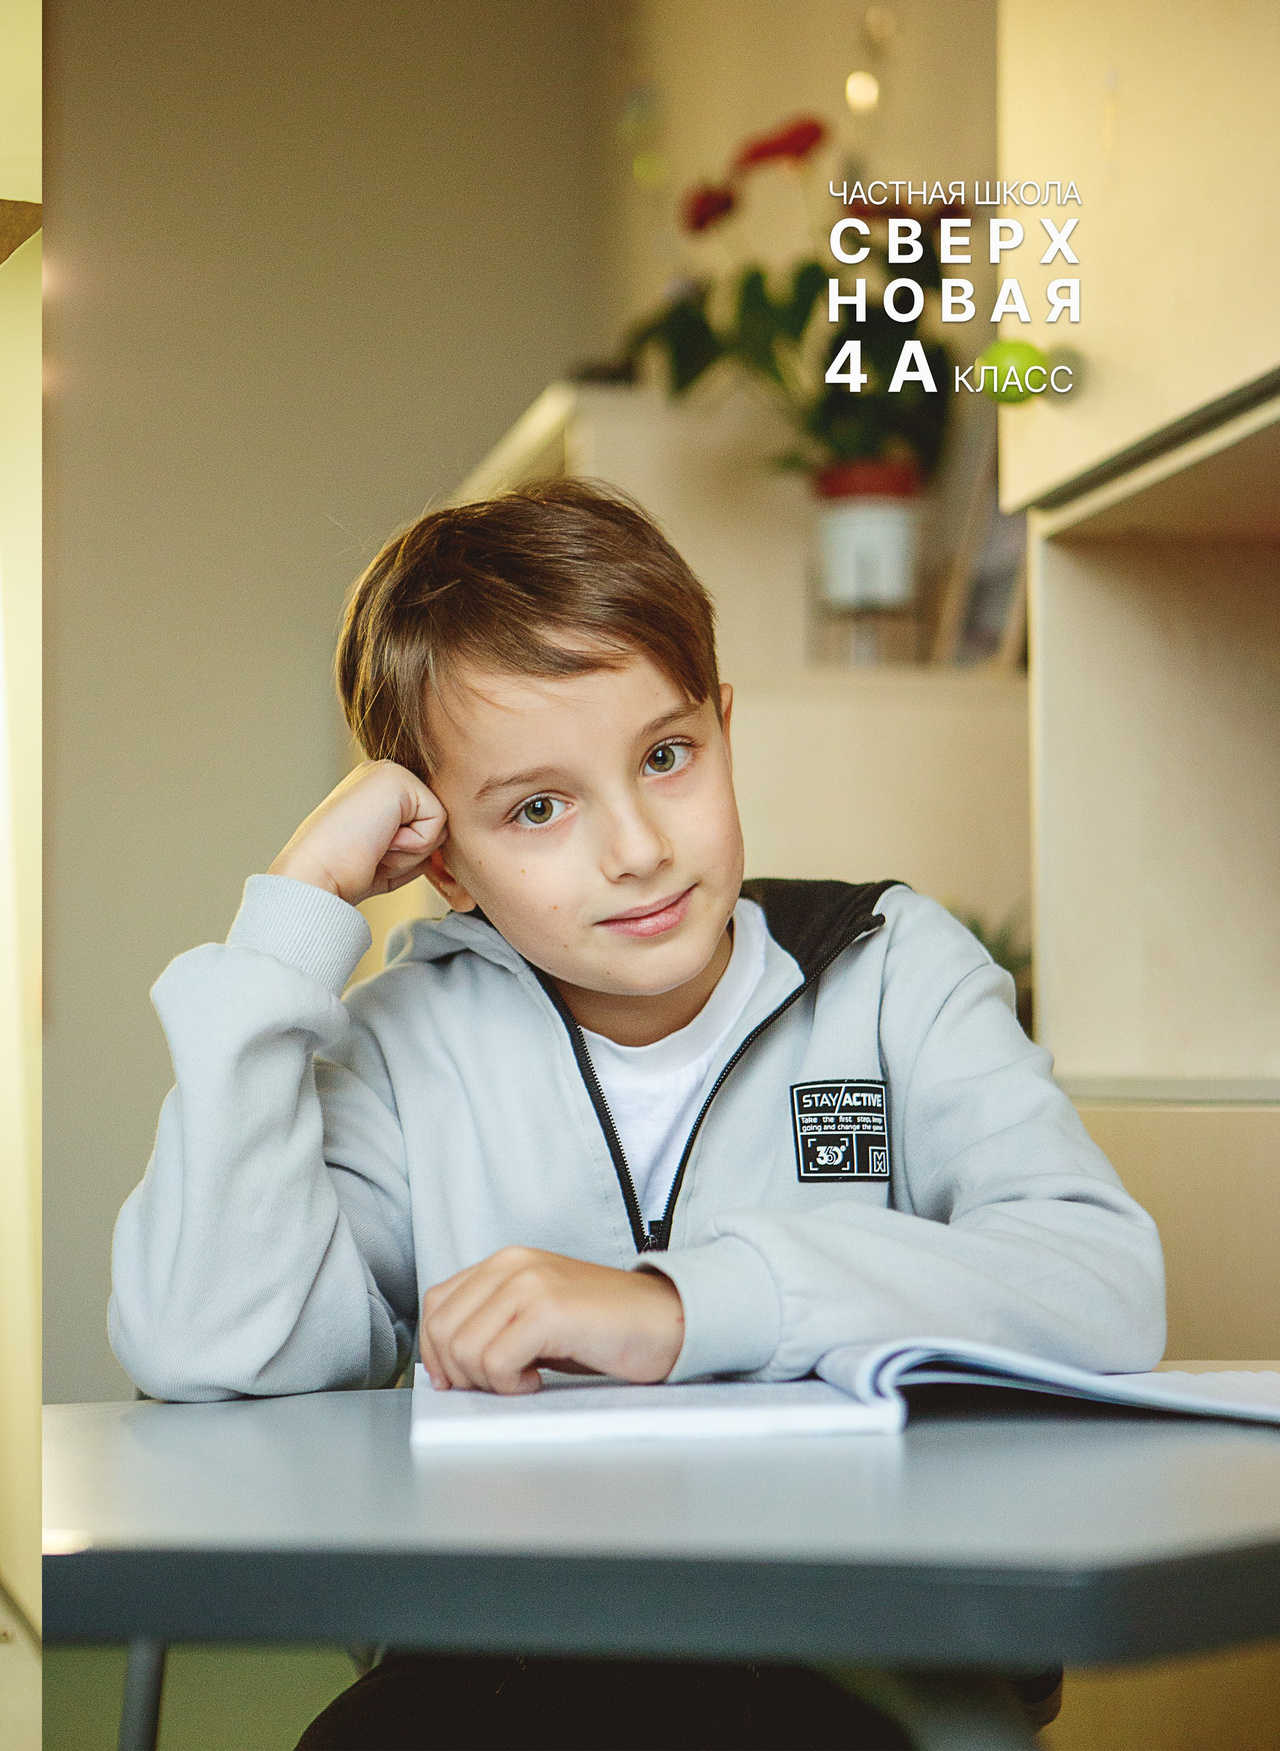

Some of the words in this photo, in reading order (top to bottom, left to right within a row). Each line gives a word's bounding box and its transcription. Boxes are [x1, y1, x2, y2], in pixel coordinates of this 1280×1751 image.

[802, 1092, 839, 1108] STAY
[841, 1092, 883, 1108] ACTIVE
[801, 1116, 818, 1124] Take
[839, 1115, 853, 1123] first
[801, 1124, 822, 1133] going
[837, 1124, 861, 1132] change
